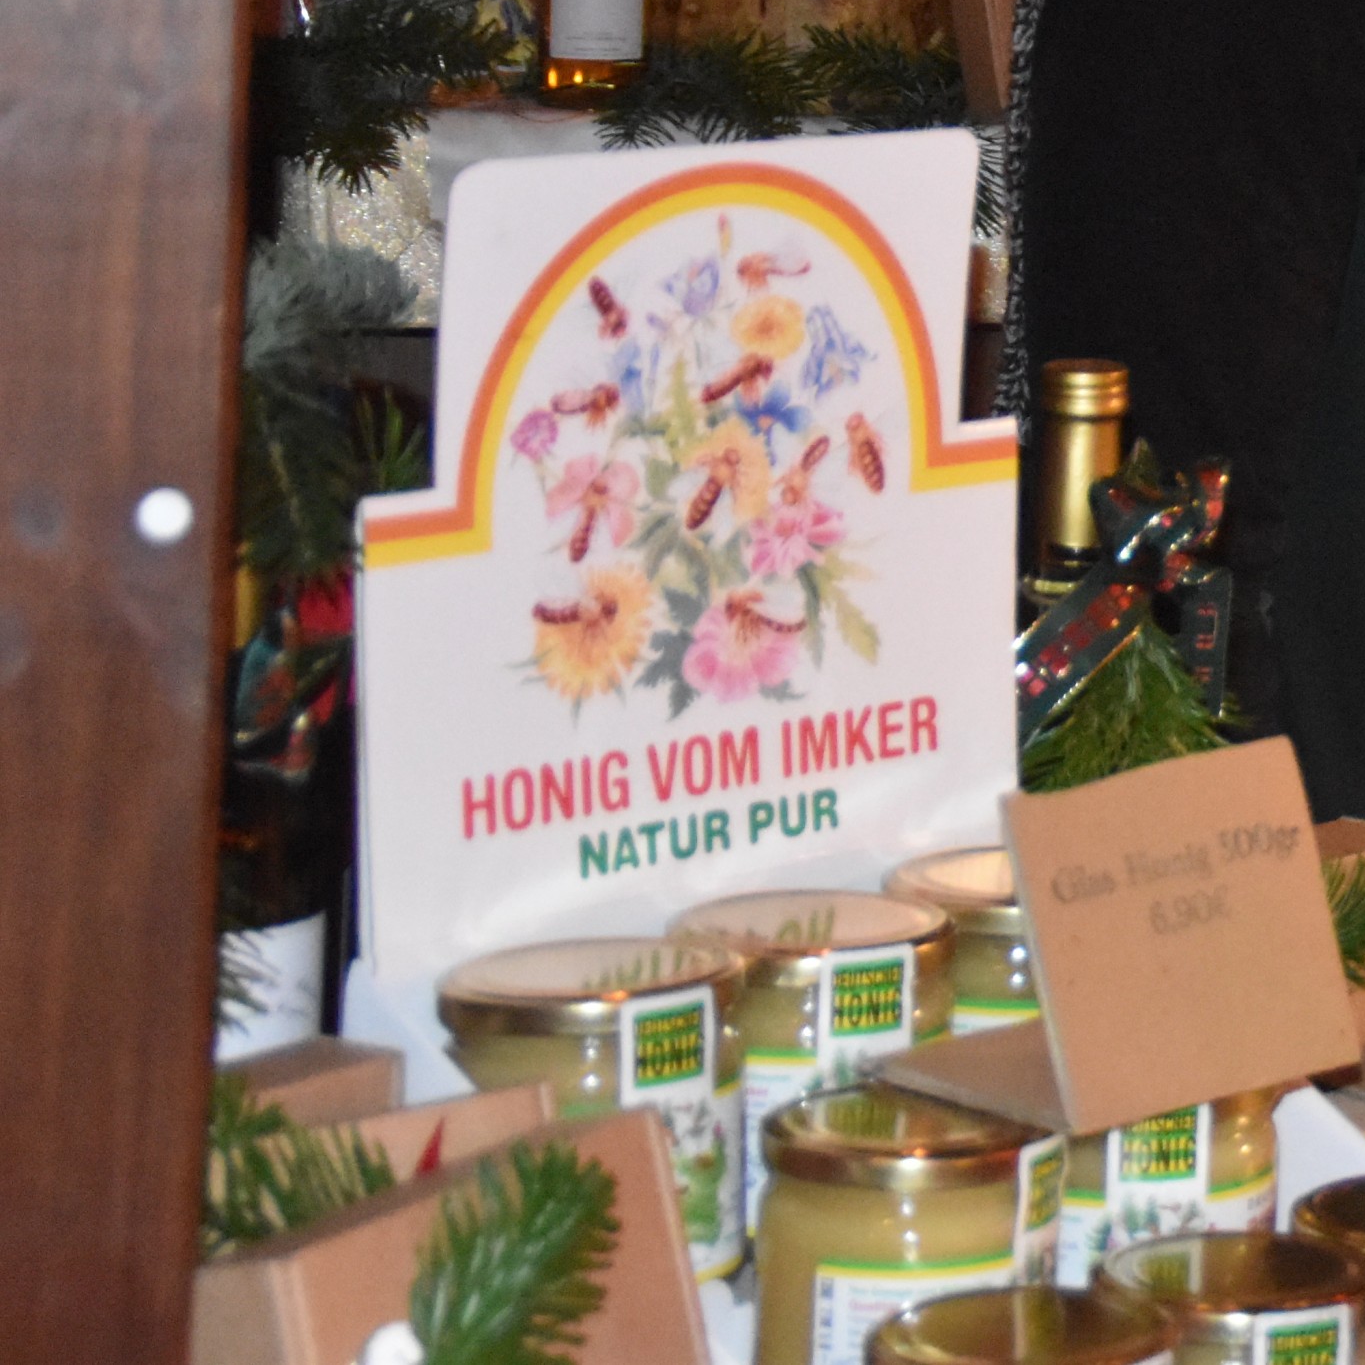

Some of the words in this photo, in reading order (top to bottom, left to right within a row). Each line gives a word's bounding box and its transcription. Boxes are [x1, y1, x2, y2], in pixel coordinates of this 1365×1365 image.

[460, 749, 631, 840] HONIG
[646, 725, 760, 803] VOM
[780, 695, 939, 777] IMKER
[578, 808, 731, 880] NATUR
[748, 788, 840, 844] PUR
